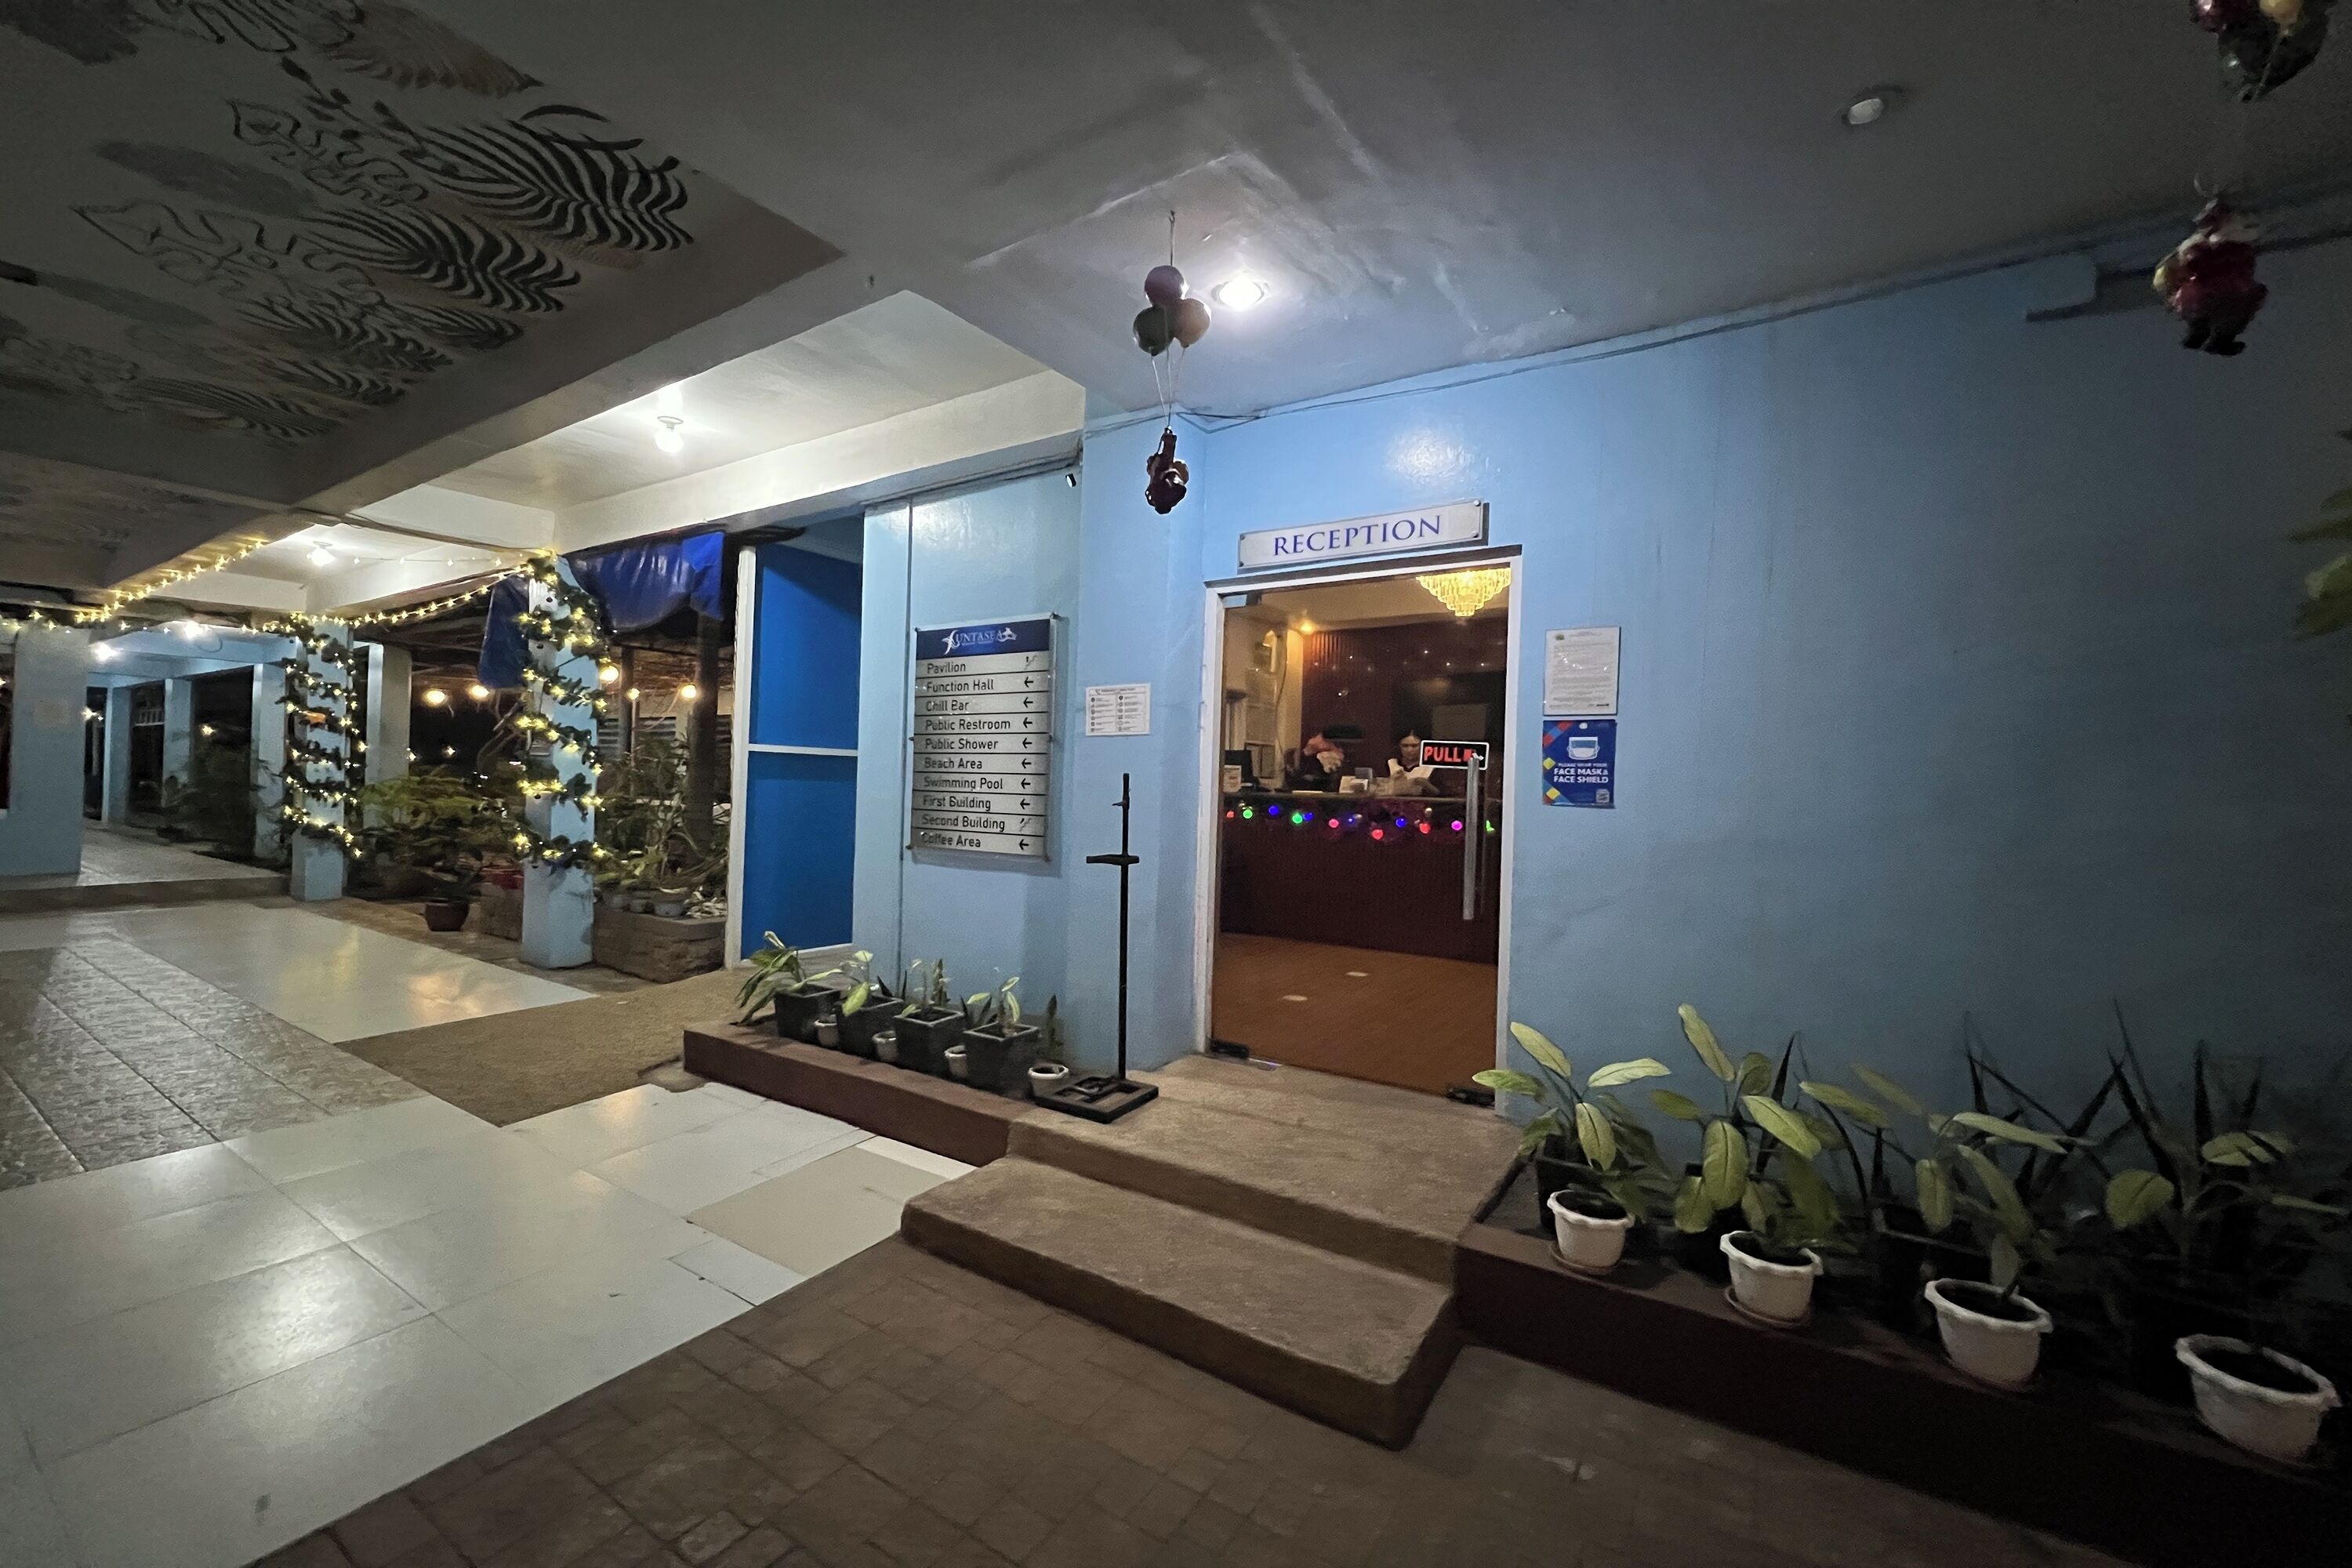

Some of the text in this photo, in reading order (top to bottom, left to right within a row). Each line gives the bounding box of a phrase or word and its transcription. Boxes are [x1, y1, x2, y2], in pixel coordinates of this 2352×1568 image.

[1274, 515, 1441, 556] RECEPTION
[927, 662, 966, 674] Pavilion
[927, 678, 993, 692] Function Hall
[926, 699, 969, 712] Chill Bar
[925, 718, 1010, 730] Public Restroom
[925, 738, 998, 750] Public Shower
[1424, 746, 1461, 762] PULL
[924, 757, 982, 769] Beach Area
[924, 777, 1003, 789] Swimming Pool
[923, 796, 991, 811] First Building
[922, 814, 1005, 830] Second Building
[922, 833, 981, 848] Coffee Area
